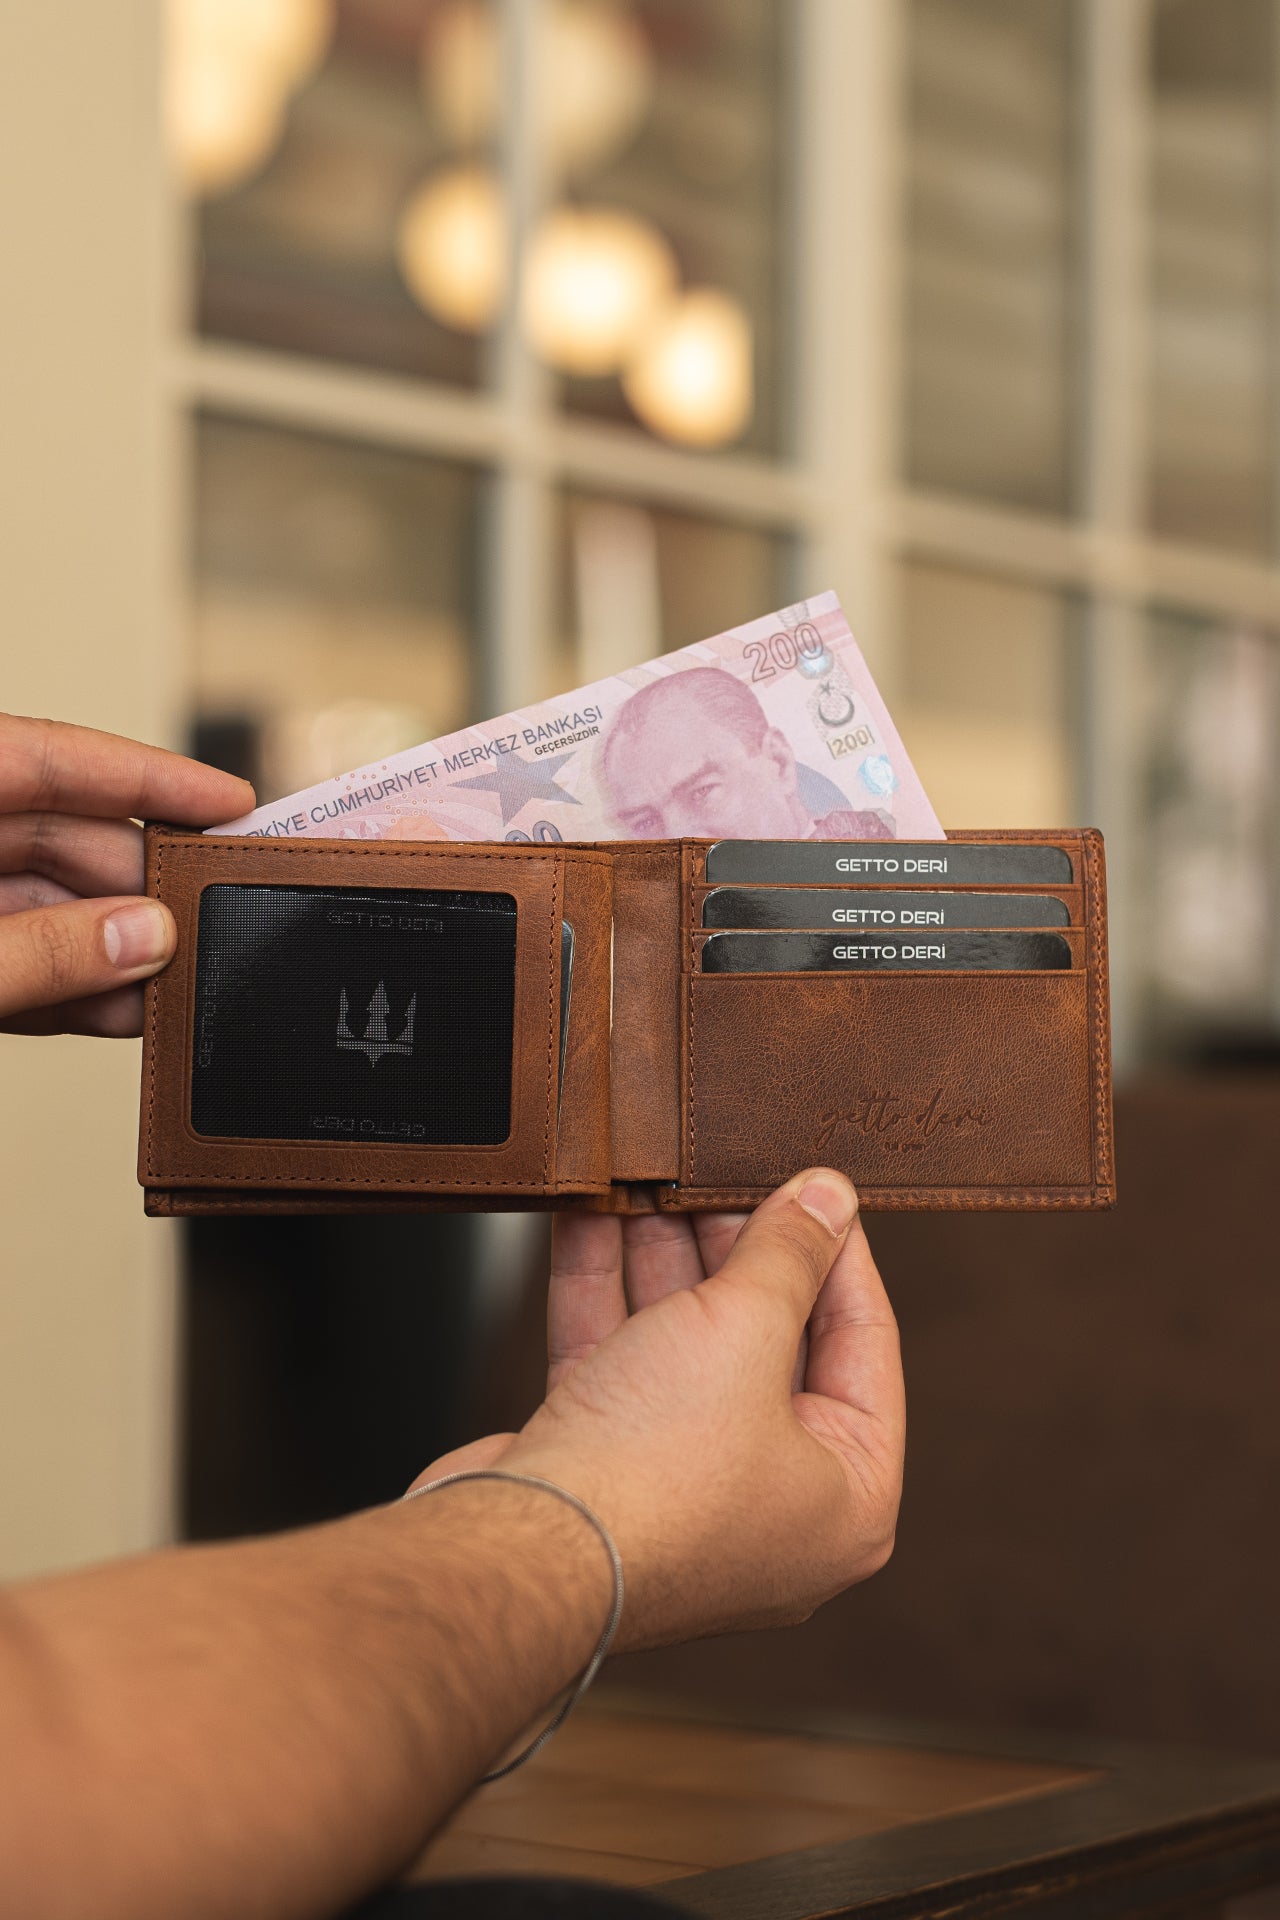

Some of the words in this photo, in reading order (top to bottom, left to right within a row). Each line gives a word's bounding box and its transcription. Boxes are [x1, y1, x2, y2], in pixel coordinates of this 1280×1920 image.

[743, 622, 824, 682] 200
[534, 726, 600, 756] GEÇERSİZDİR
[832, 729, 869, 756] 200
[310, 762, 439, 824] CUMHURİYET
[444, 734, 522, 774] MERKEZ
[522, 705, 603, 745] BANKASI
[835, 858, 899, 872] GETTO
[903, 857, 948, 873] DERİ
[326, 910, 394, 927] GETTO
[832, 909, 896, 923] GETTO
[900, 909, 945, 925] DERİ
[832, 945, 897, 959] GETTO
[901, 943, 946, 959] DERİ
